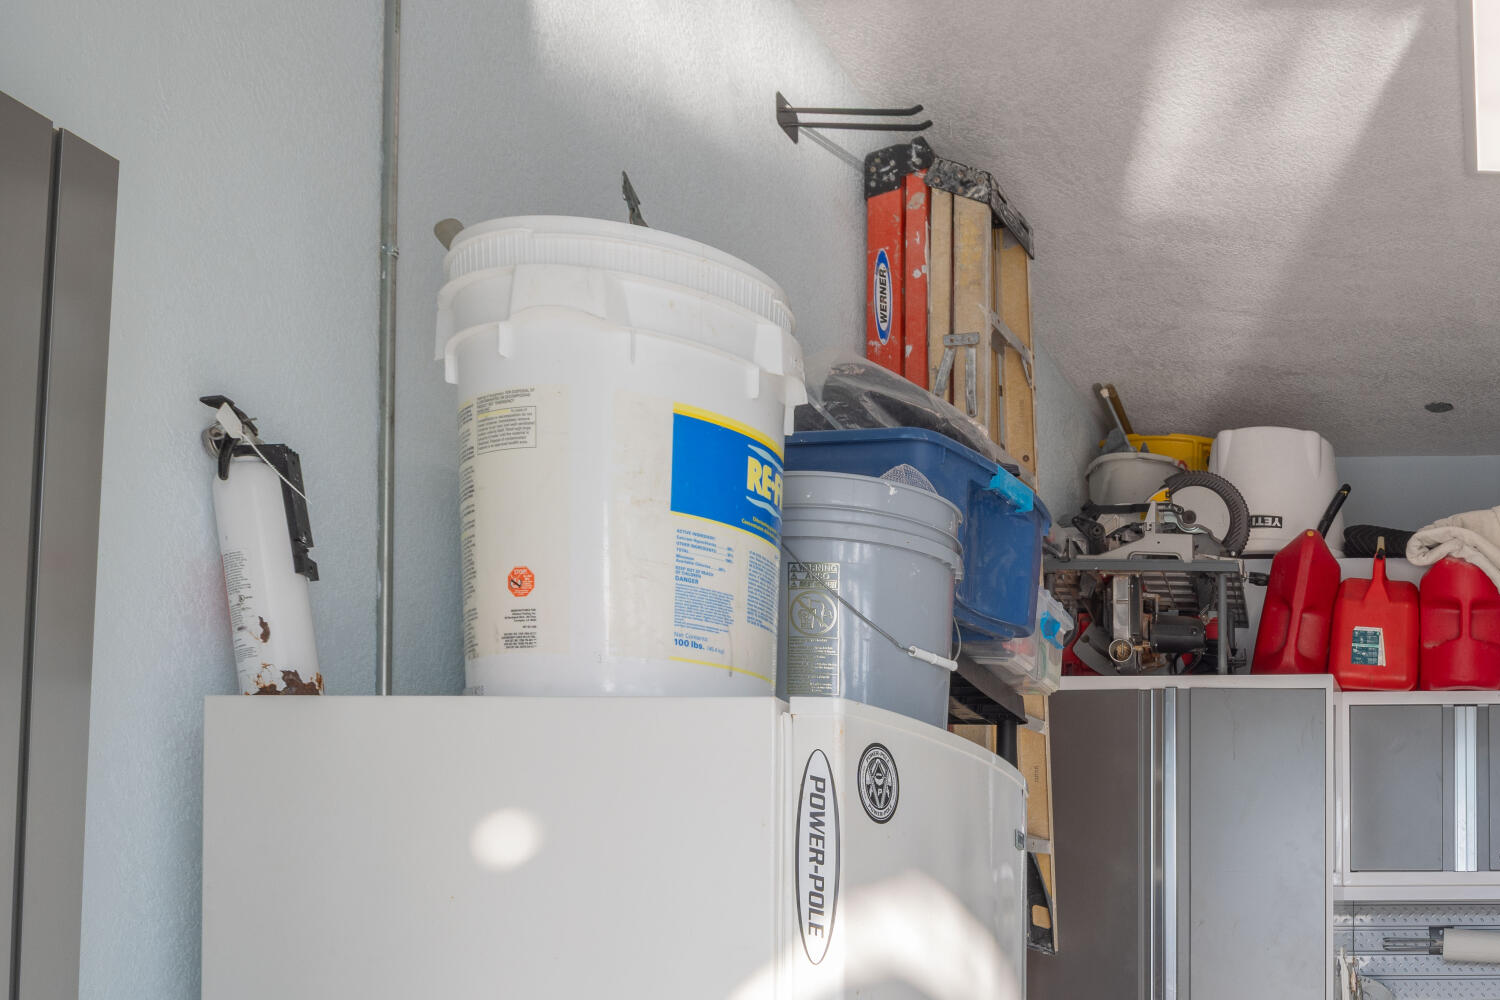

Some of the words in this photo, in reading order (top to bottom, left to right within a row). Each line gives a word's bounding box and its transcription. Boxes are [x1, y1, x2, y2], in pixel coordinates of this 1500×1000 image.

[879, 269, 887, 323] WERNER
[1252, 516, 1282, 527] YETI
[675, 575, 699, 585] DANGER
[674, 638, 690, 648] 100
[691, 641, 705, 650] lbs.
[808, 774, 826, 938] POWER-POLE
